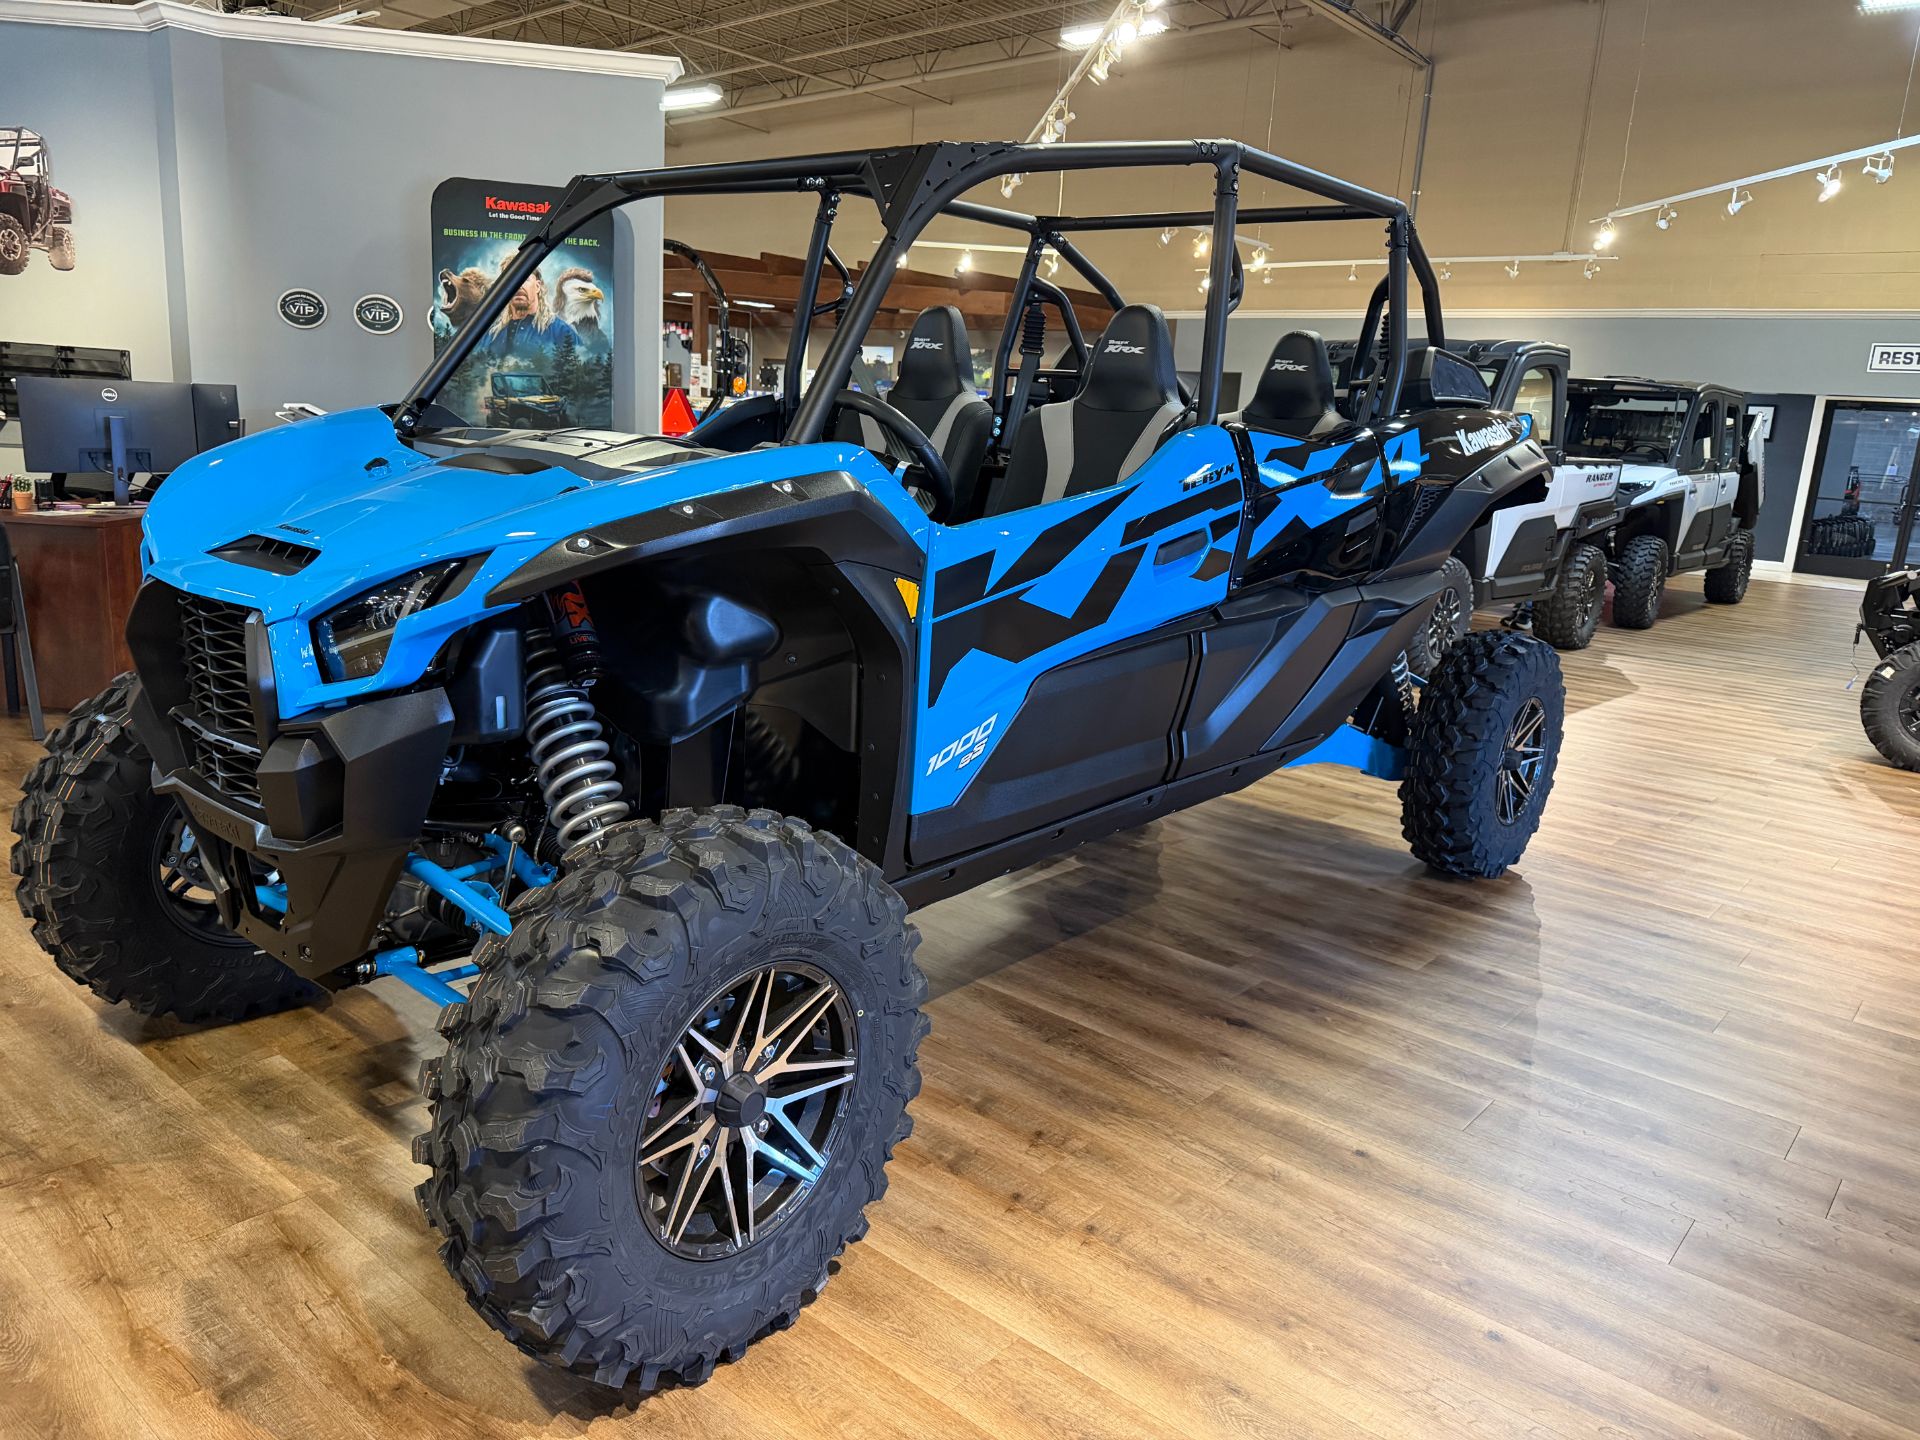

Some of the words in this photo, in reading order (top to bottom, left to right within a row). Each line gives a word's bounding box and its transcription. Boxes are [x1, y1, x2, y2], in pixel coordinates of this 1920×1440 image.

[485, 196, 552, 214] Kawasak
[443, 228, 479, 237] BUSINESS
[480, 230, 488, 238] IN
[489, 231, 503, 239] THE
[504, 232, 528, 241] FRONT
[564, 237, 578, 245] THE
[578, 238, 600, 247] BACK.
[290, 304, 314, 315] VIP
[365, 310, 390, 321] VIP
[910, 341, 944, 350] KRX
[1103, 344, 1147, 355] KRX
[1270, 363, 1309, 372] KRX
[1455, 418, 1514, 457] Kawasaki
[1585, 472, 1614, 483] RANGER
[925, 712, 999, 777] 1000
